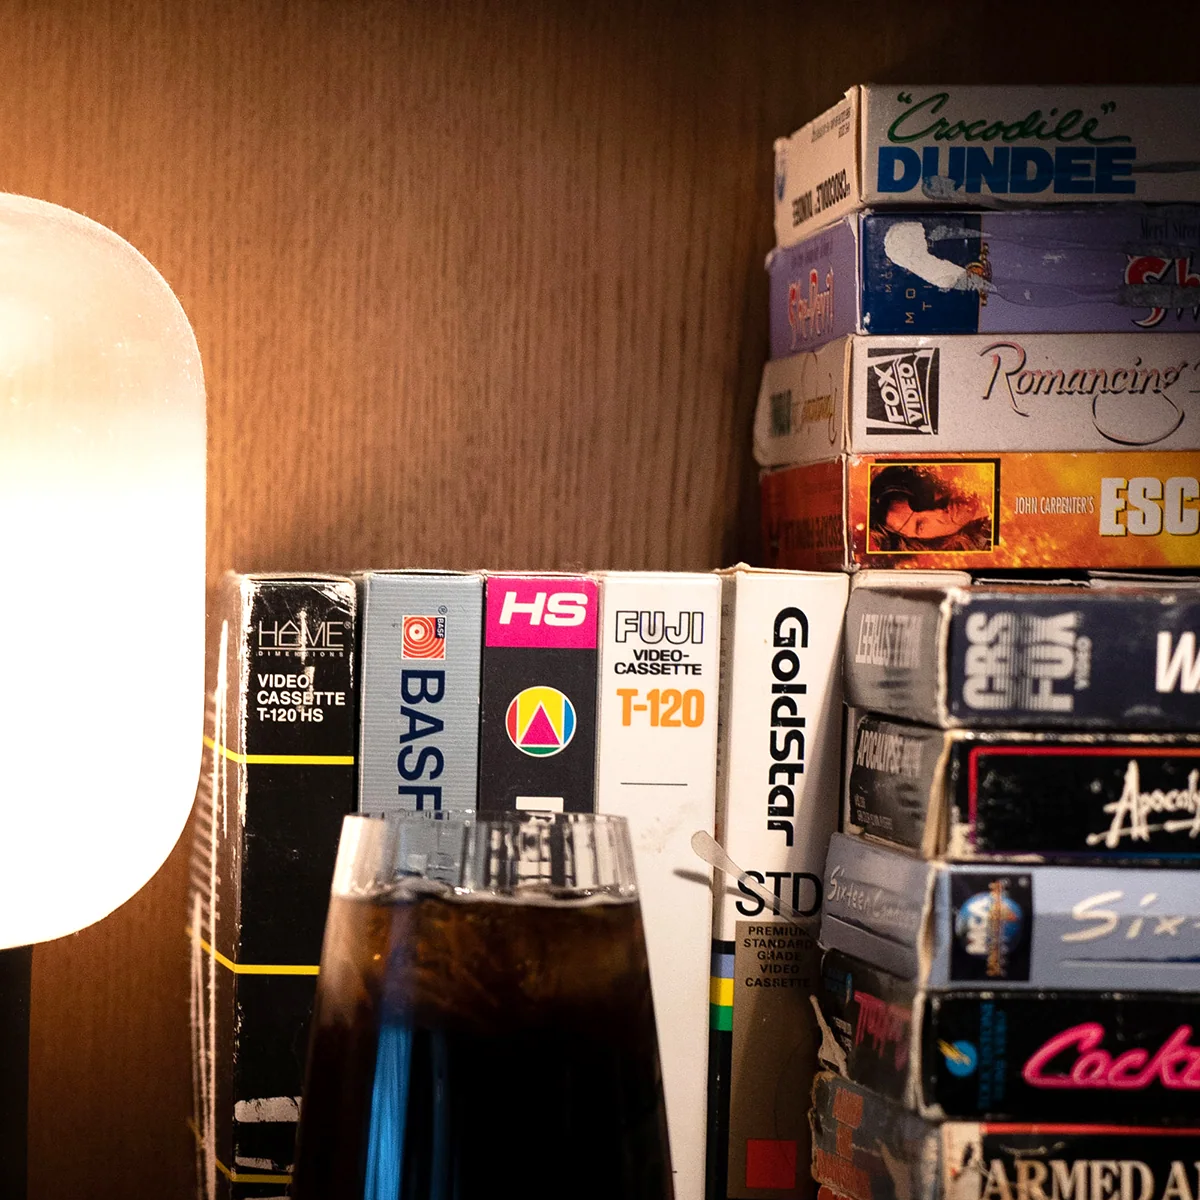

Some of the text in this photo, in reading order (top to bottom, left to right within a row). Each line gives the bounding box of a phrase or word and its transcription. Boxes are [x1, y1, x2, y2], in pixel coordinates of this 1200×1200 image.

[877, 147, 1137, 195] DUNDEE
[873, 365, 905, 423] FOX
[899, 362, 923, 425] VIDEO
[979, 341, 1187, 446] Romancing
[1014, 477, 1200, 538] JOHN CARPENTER'S ESC
[499, 591, 588, 627] HS
[258, 619, 344, 647] HOME
[435, 617, 446, 639] BASF
[615, 610, 704, 645] FUJI
[614, 662, 702, 675] CASSETTE
[633, 648, 690, 662] VIDEO-
[962, 611, 1018, 710] CBS
[1018, 610, 1082, 713] FOX
[256, 690, 346, 706] CASSETTE
[257, 673, 311, 688] VIDEO
[256, 707, 324, 722] T-120 HS
[616, 688, 705, 728] T-120
[767, 606, 809, 847] GoldStar
[397, 669, 446, 820] BASF
[736, 871, 823, 917] STD
[743, 938, 815, 949] STANDARD
[757, 950, 803, 961] GRADE
[745, 976, 811, 988] CASSETTE
[759, 963, 801, 975] VIDEO
